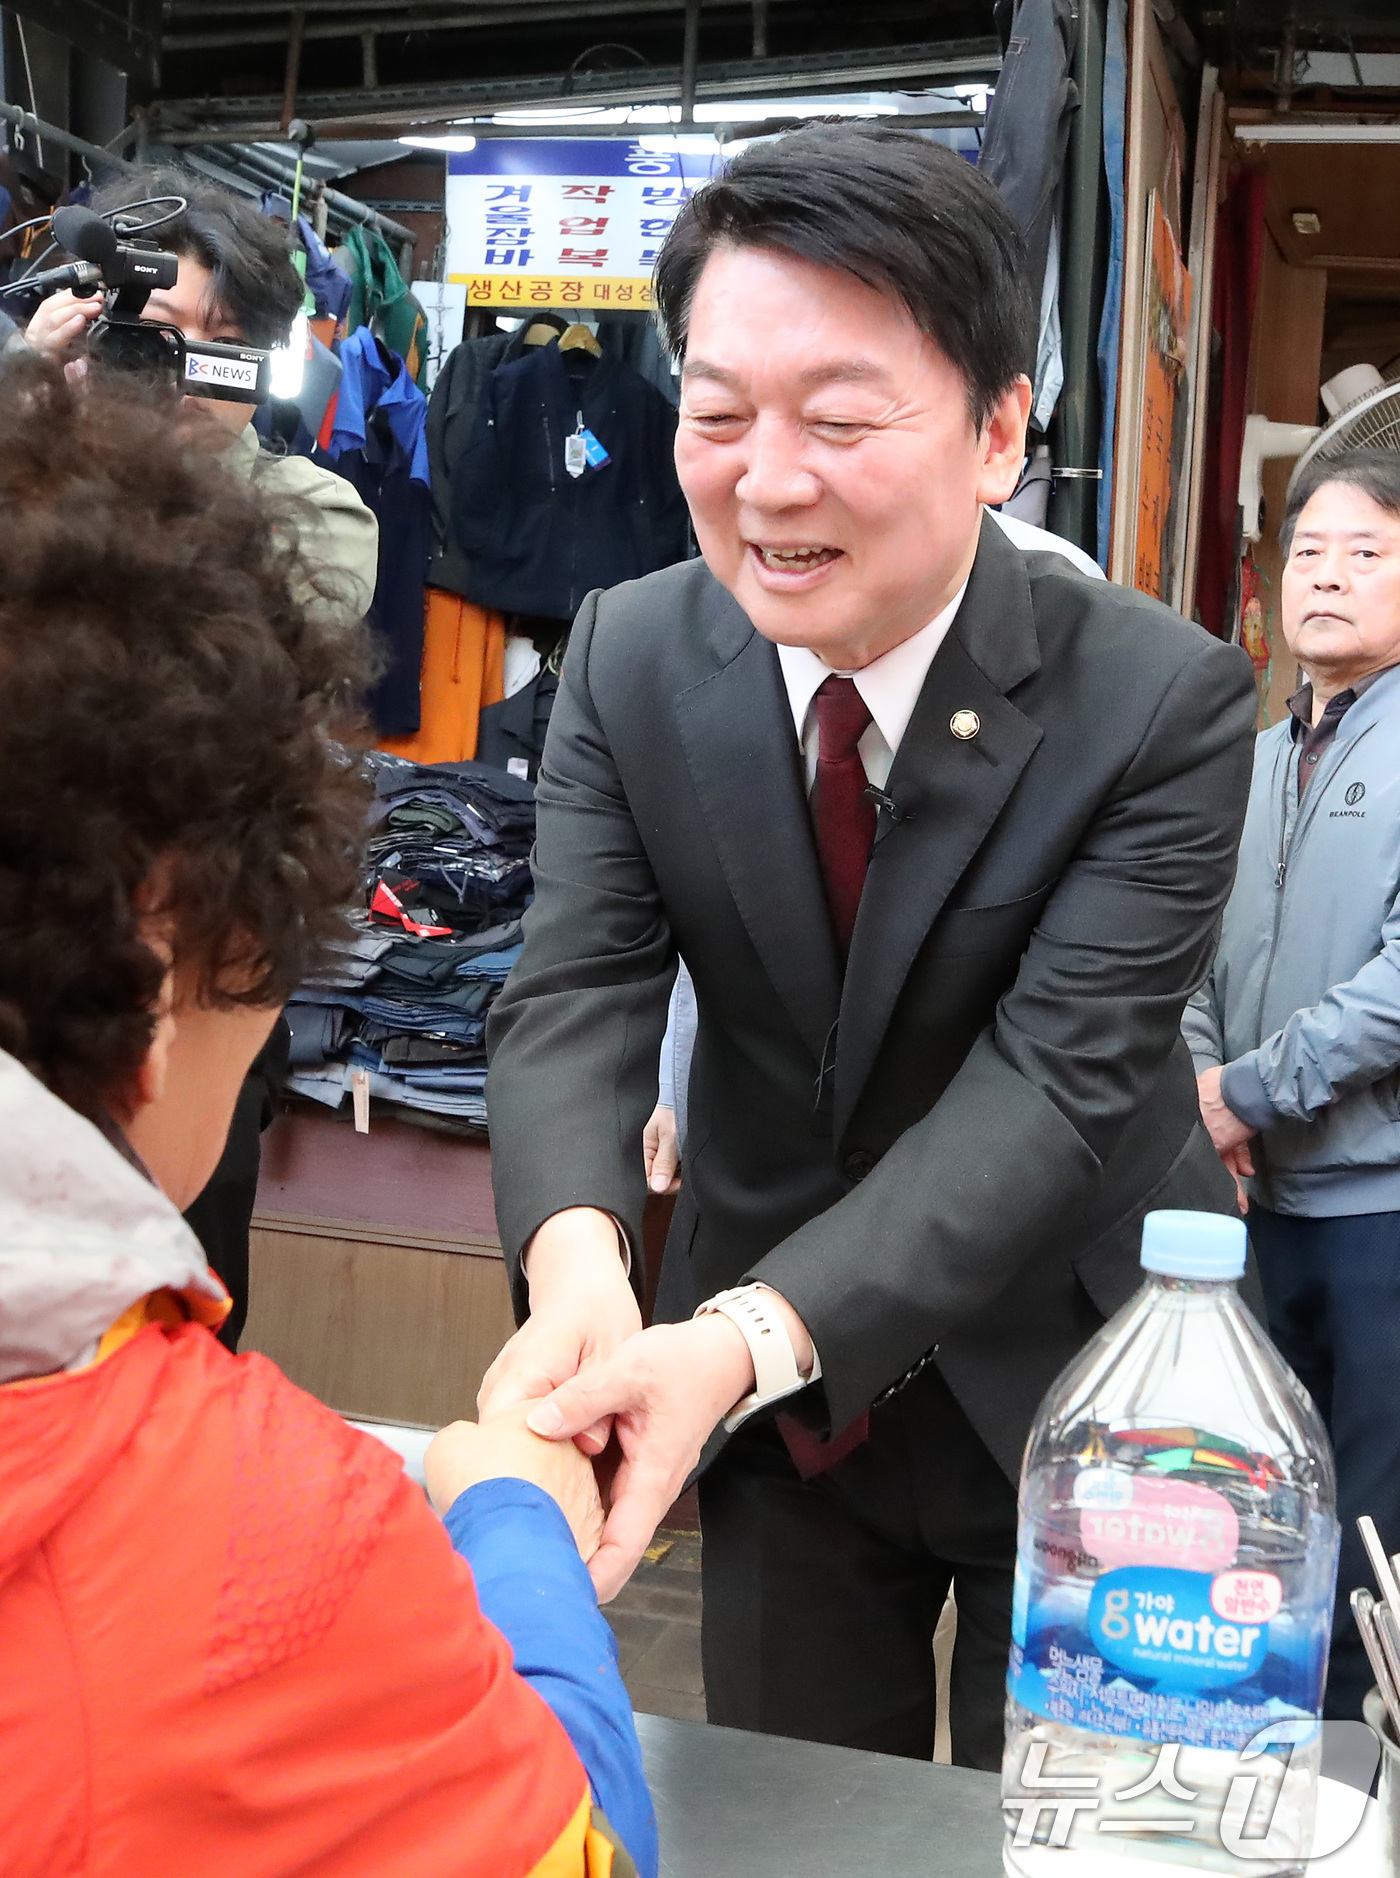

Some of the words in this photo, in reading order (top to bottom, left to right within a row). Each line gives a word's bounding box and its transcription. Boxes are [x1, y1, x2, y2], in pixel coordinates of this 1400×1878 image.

[484, 184, 535, 267] 겨울잠바
[557, 184, 616, 268] 작업복
[134, 265, 158, 275] SONY
[469, 279, 585, 302] 생산공장
[240, 353, 264, 362] SONY
[212, 365, 252, 382] NEWS
[1134, 1591, 1175, 1612] 가야
[1101, 1589, 1130, 1640] g
[1134, 1613, 1261, 1657] water
